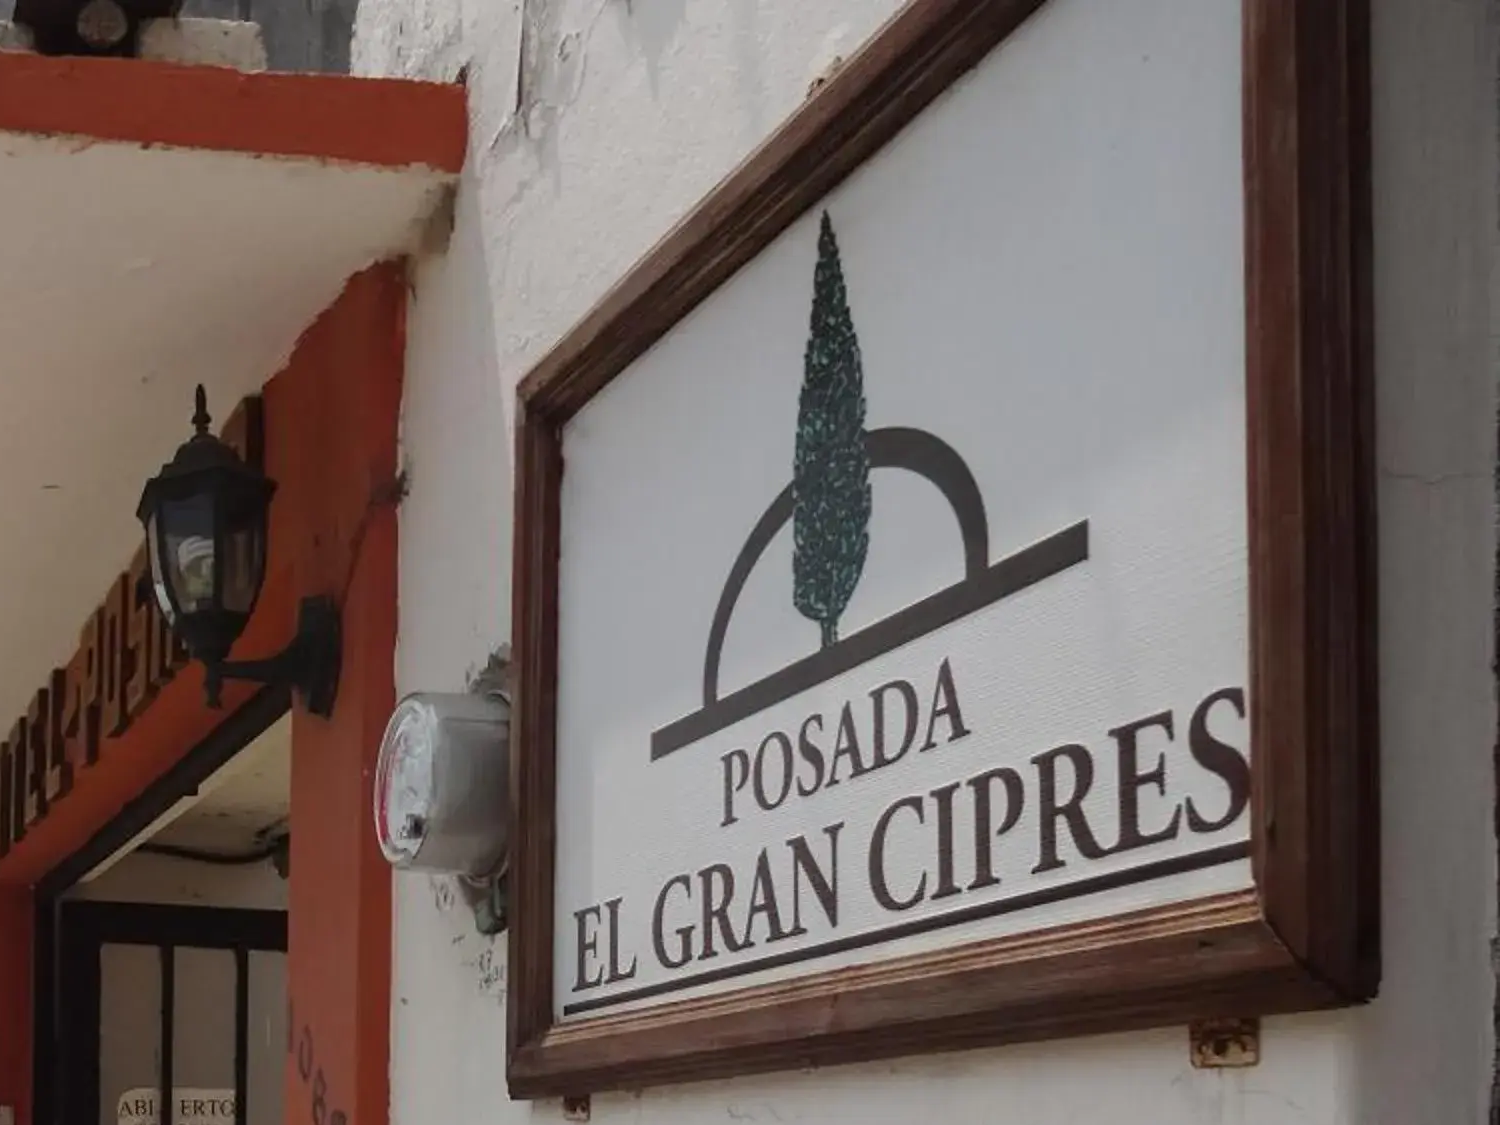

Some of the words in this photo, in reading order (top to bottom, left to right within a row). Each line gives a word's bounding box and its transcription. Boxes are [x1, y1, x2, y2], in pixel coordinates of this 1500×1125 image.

[571, 896, 638, 993] EL
[651, 822, 846, 970] GRAN
[867, 686, 1252, 913] CIPRES
[720, 656, 972, 828] POSADA
